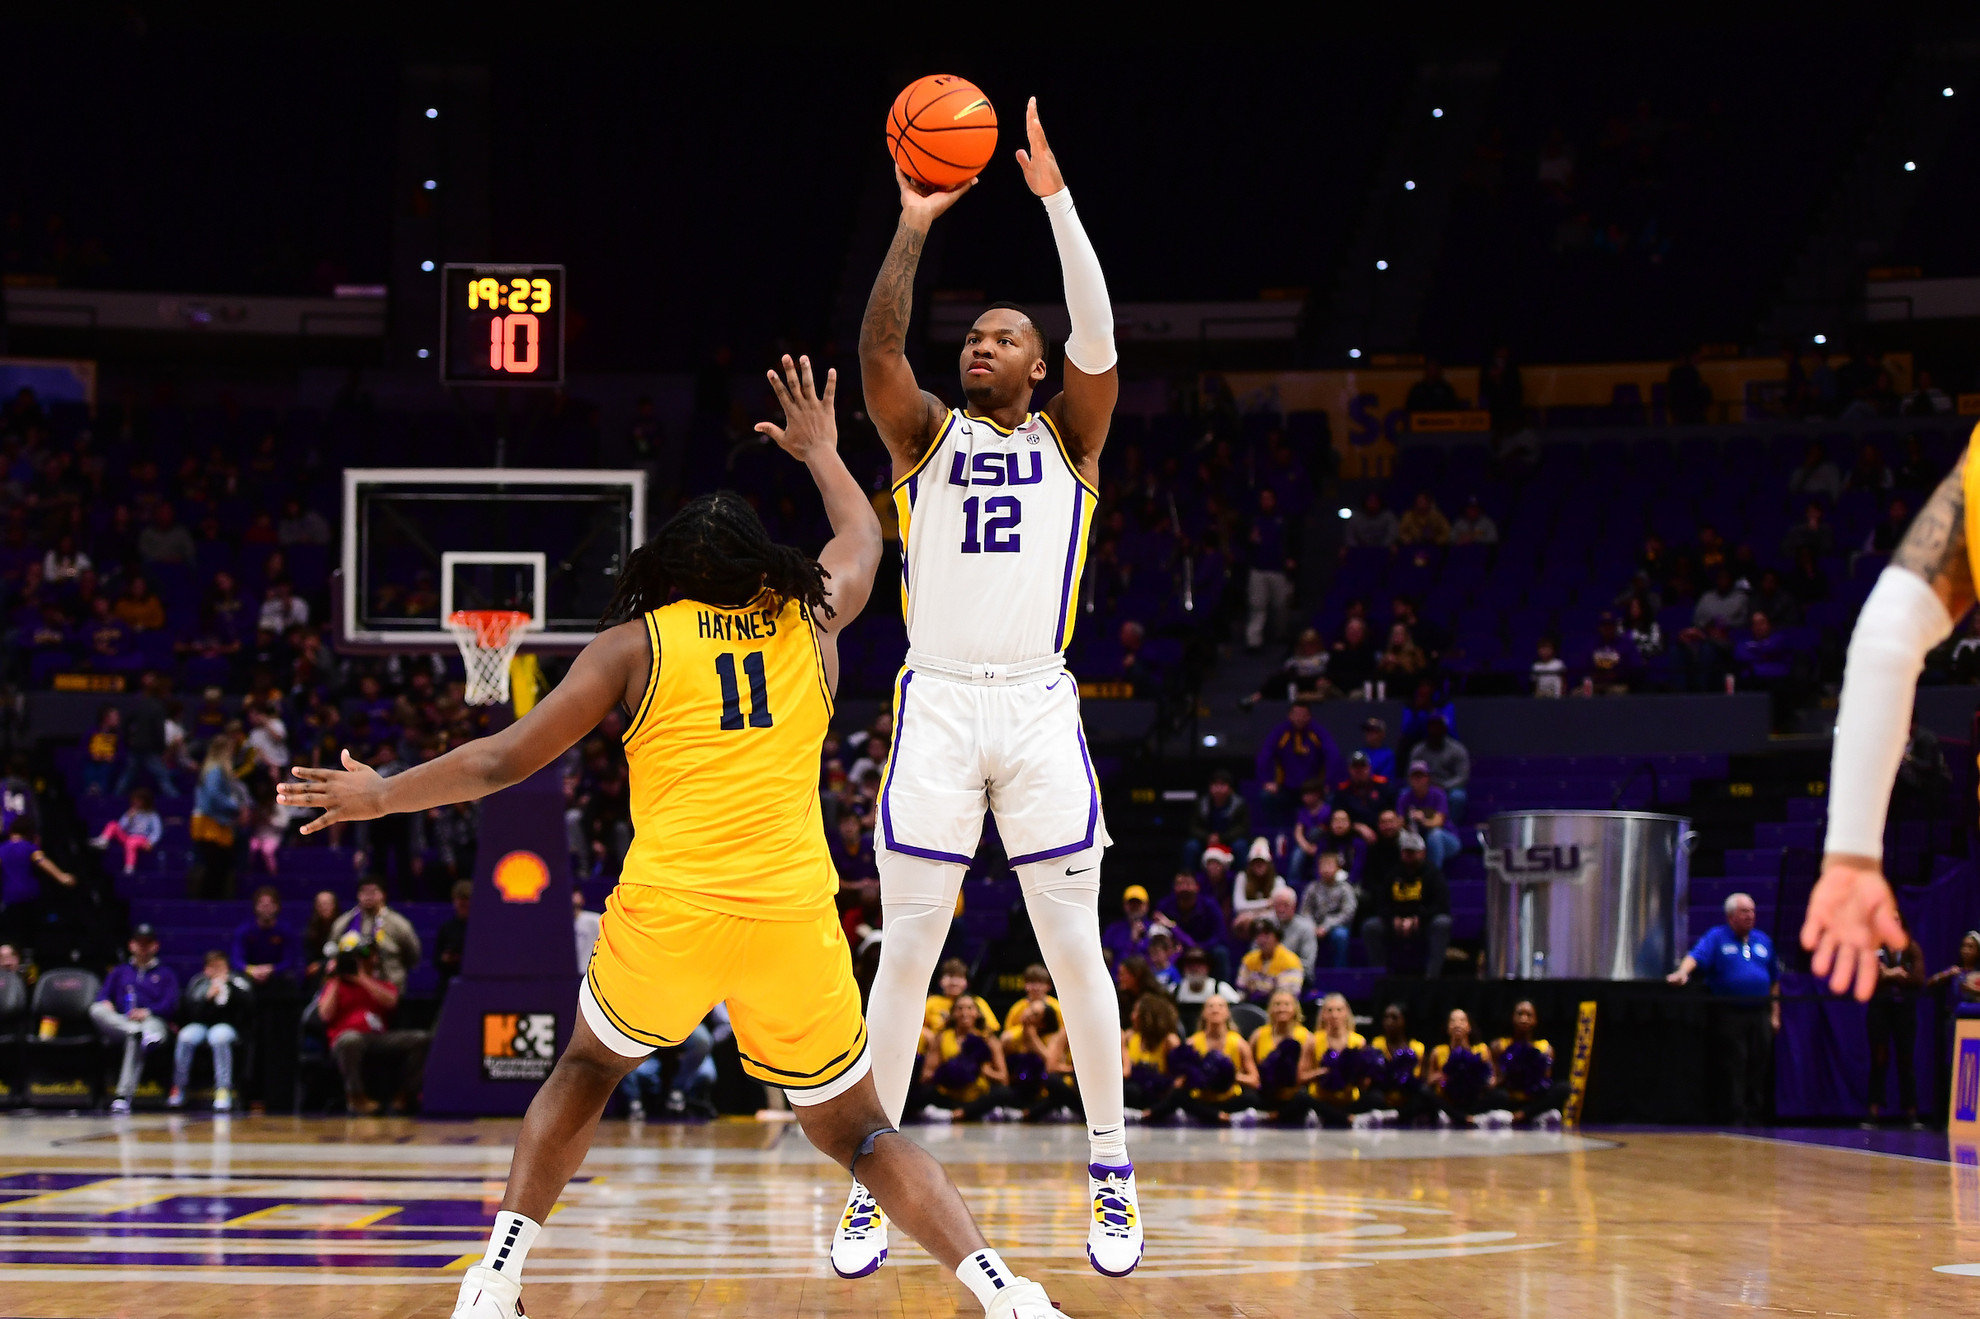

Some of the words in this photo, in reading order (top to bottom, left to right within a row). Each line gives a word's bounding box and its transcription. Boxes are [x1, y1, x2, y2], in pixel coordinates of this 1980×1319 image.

[468, 277, 552, 313] 19:23
[490, 313, 540, 373] 10
[948, 451, 1043, 487] LSU
[961, 496, 1022, 554] 12
[697, 609, 777, 641] HAYNES
[715, 651, 773, 731] 11
[1503, 845, 1580, 873] LSU
